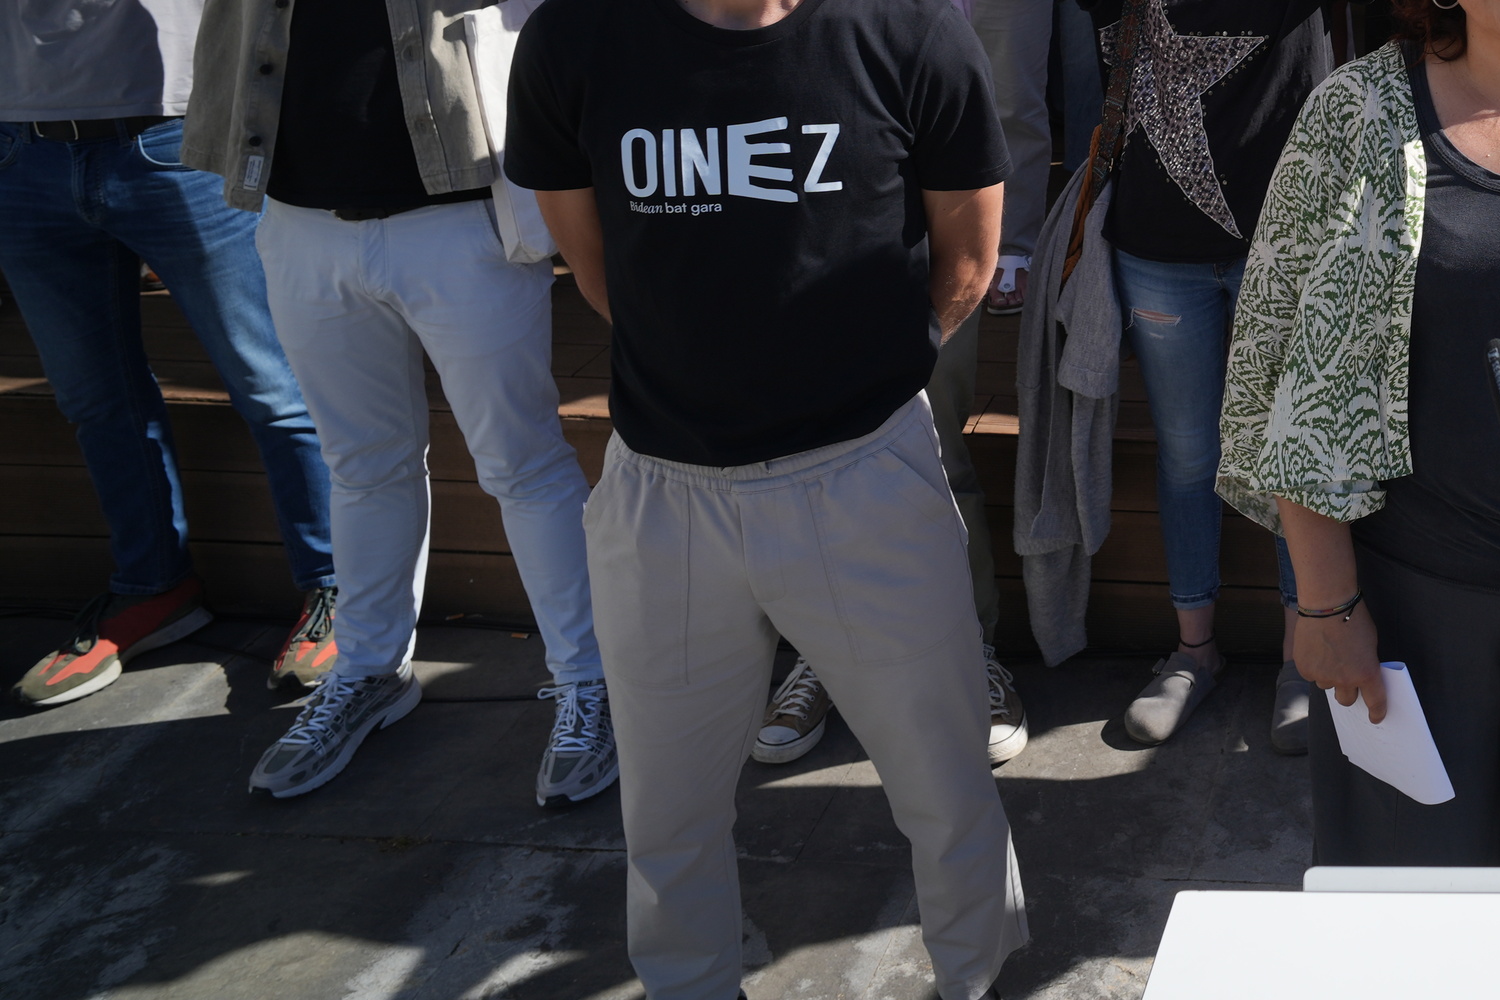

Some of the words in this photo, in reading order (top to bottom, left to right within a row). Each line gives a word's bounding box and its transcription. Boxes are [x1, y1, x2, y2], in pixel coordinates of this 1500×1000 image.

[620, 116, 843, 203] OINEZ
[630, 201, 664, 215] Bidean
[665, 201, 687, 214] bat
[691, 202, 723, 217] gara
